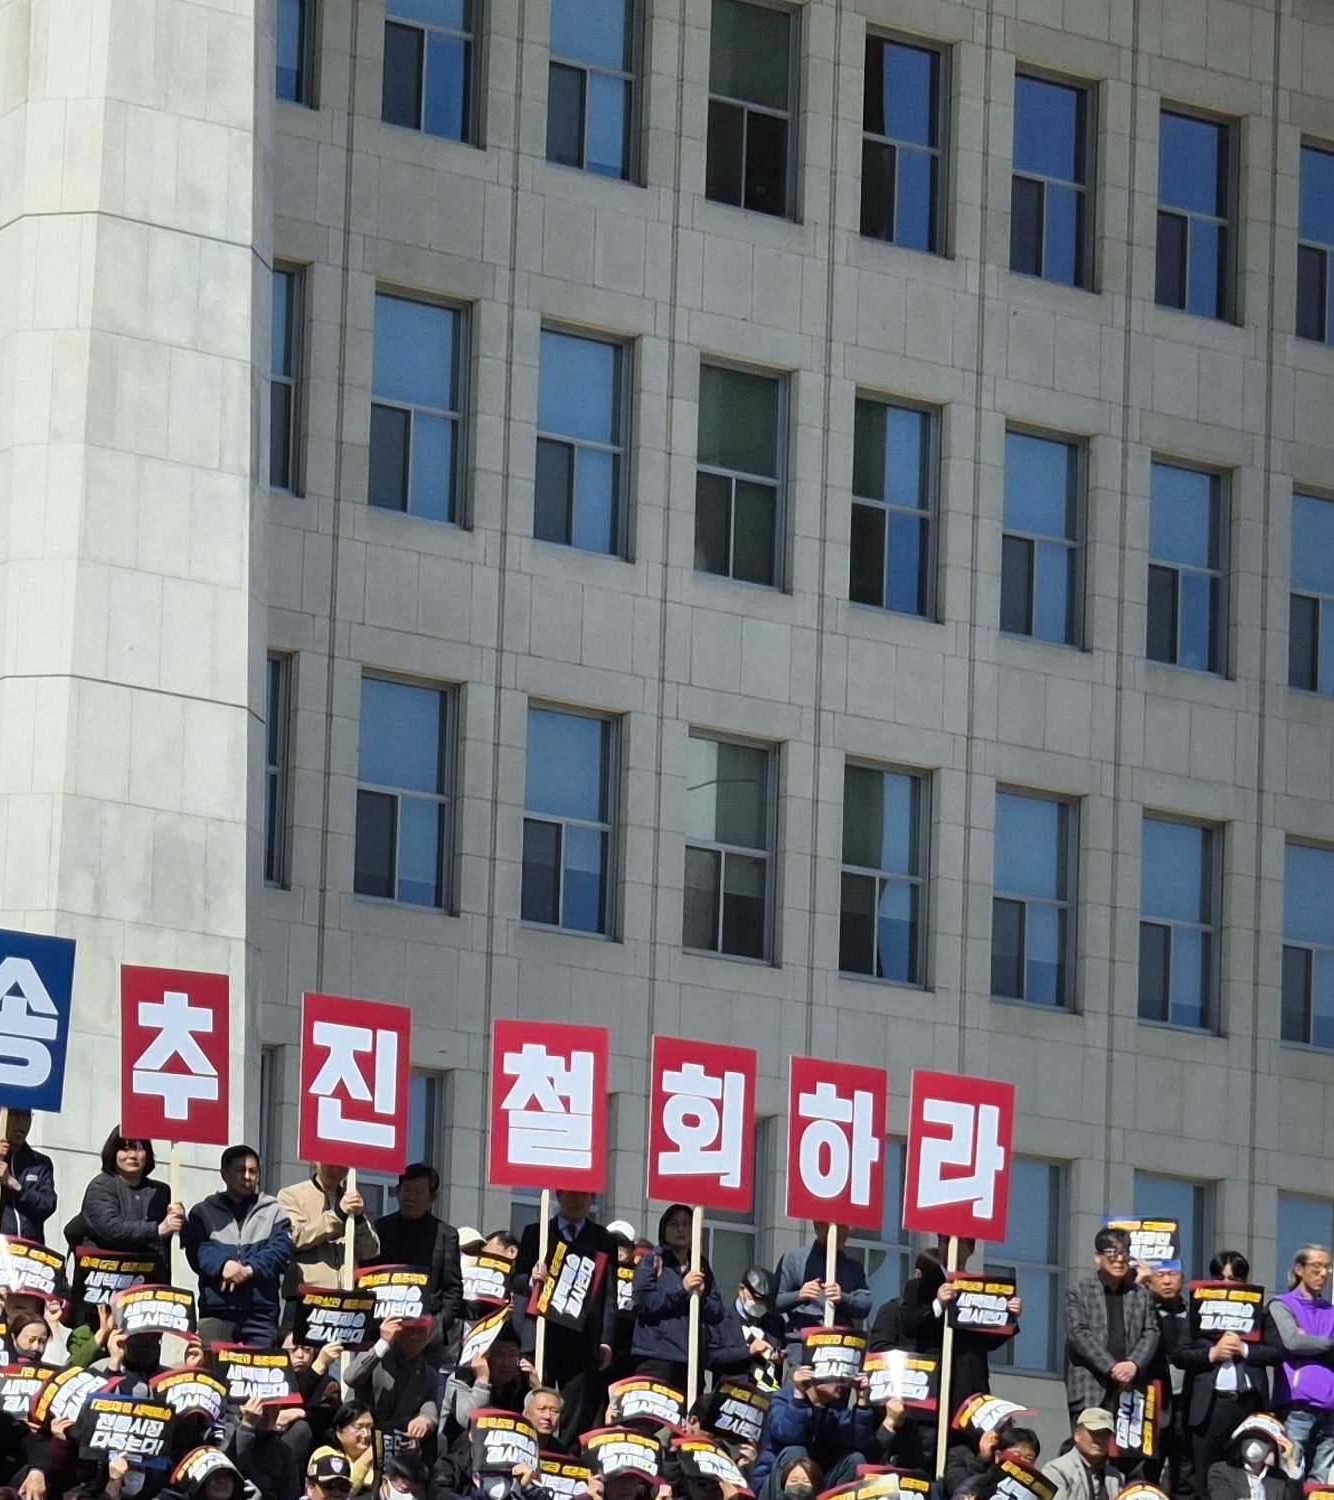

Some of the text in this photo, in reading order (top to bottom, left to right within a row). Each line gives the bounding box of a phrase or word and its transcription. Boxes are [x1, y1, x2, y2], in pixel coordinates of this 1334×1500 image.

[132, 989, 220, 1119] 추
[311, 1016, 400, 1149] 진
[502, 1046, 597, 1172] 철
[662, 1062, 746, 1189] 회
[799, 1079, 881, 1208] 하
[918, 1099, 1006, 1221] 라
